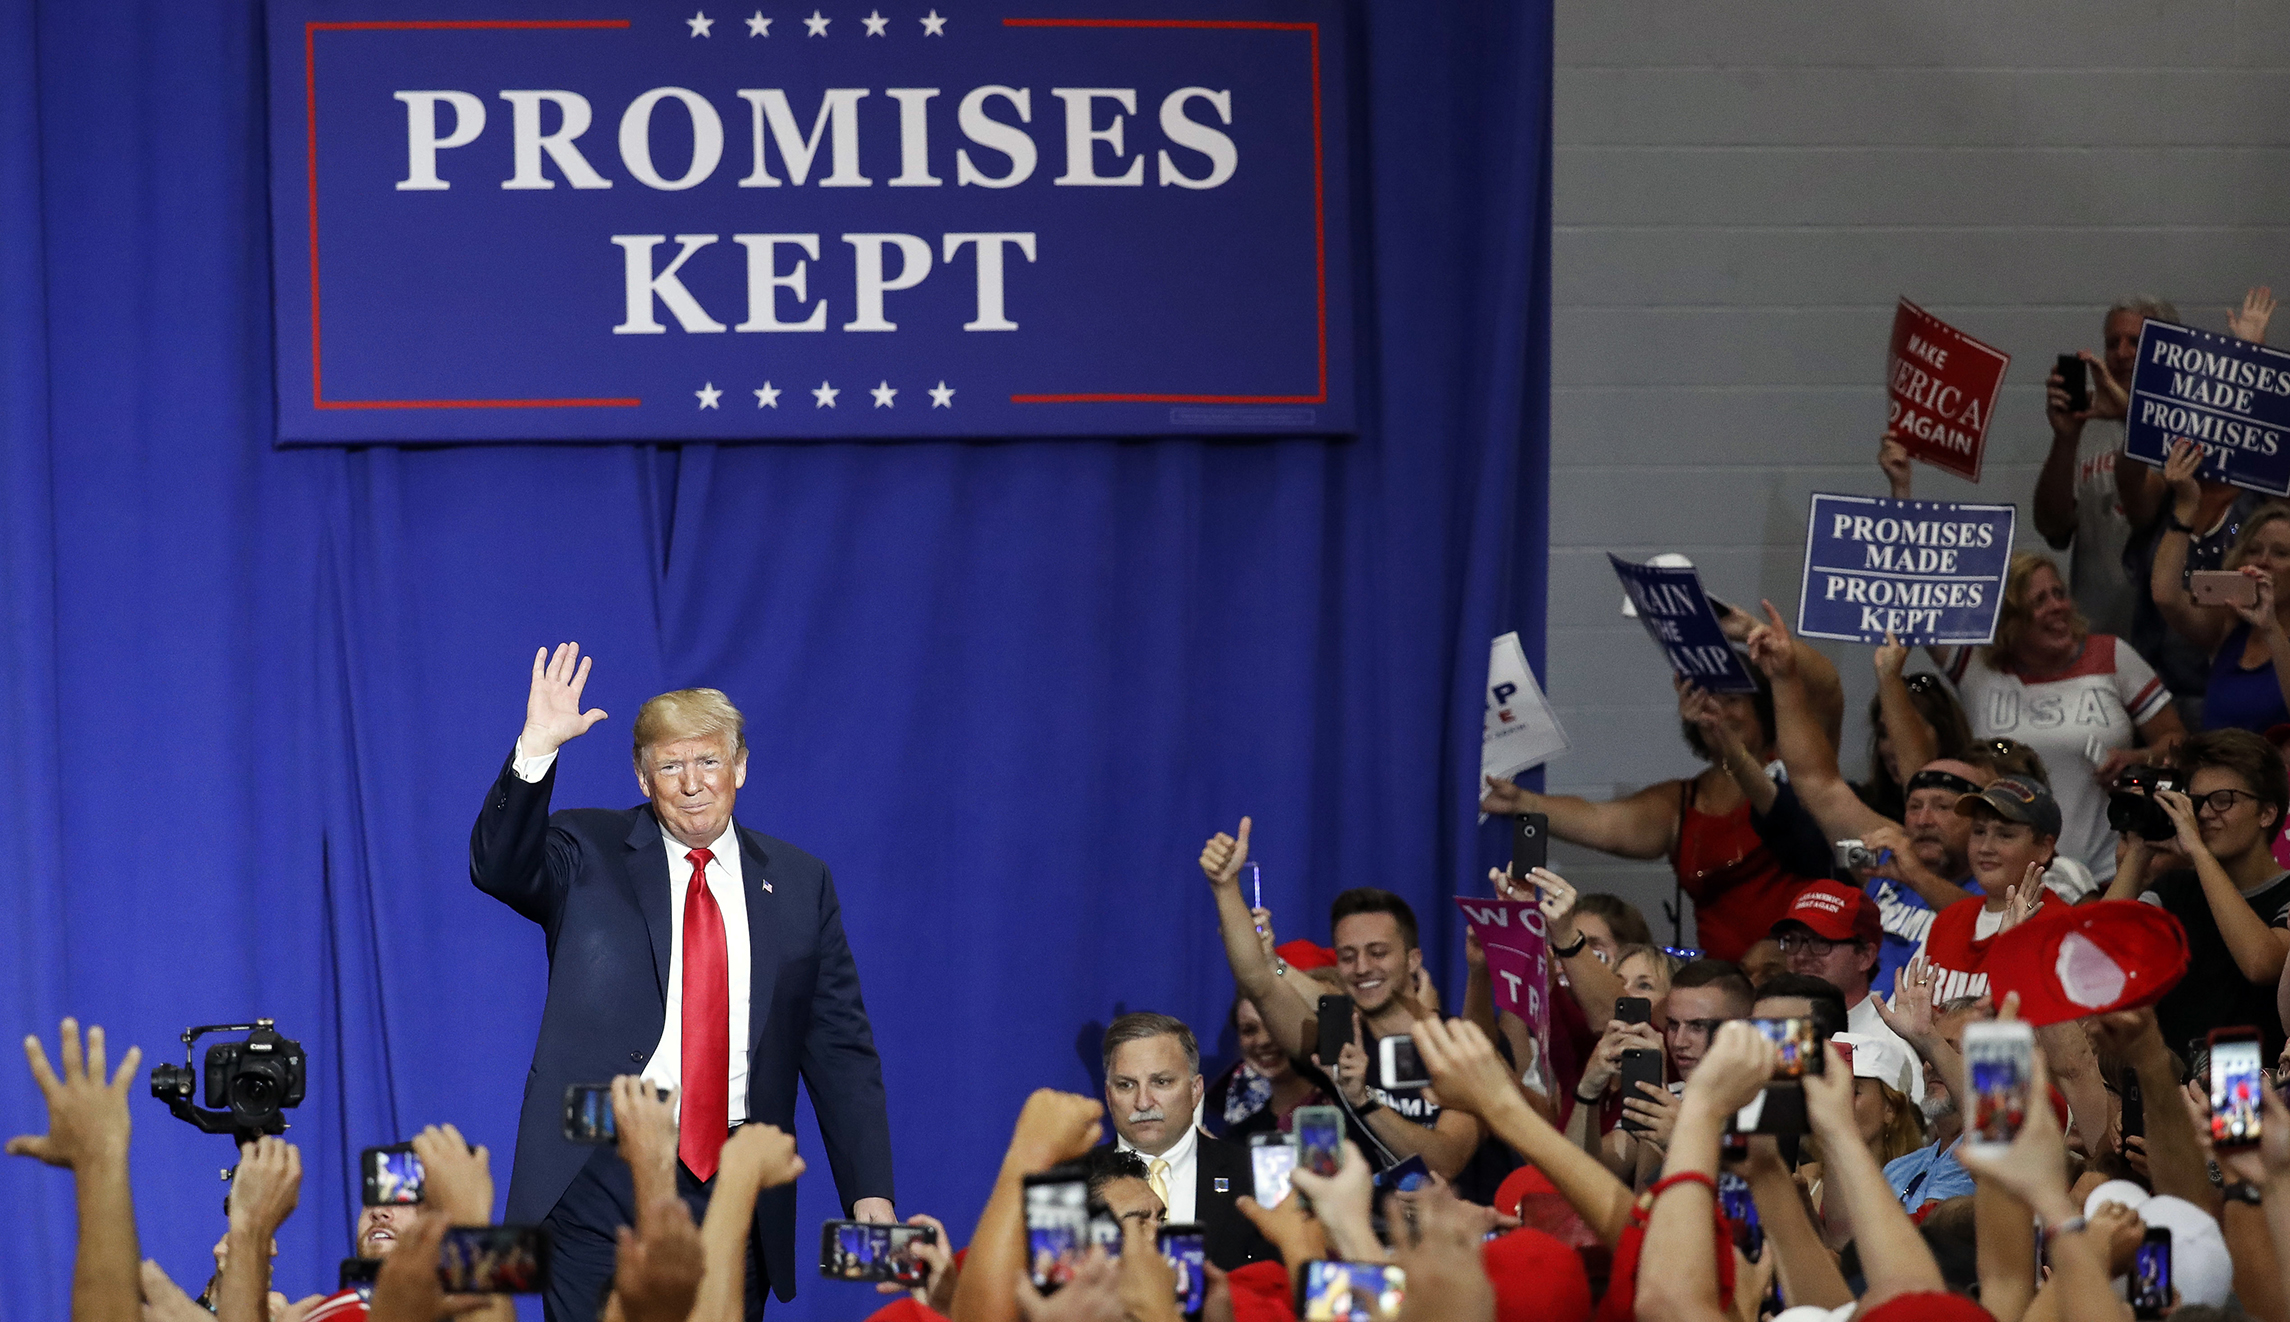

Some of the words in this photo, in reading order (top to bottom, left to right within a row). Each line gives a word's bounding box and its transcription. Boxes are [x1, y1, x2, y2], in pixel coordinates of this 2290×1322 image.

[393, 85, 1238, 191] PROMISES
[610, 232, 1037, 335] KEPT
[1907, 333, 1948, 371] MAKE
[2152, 339, 2290, 397] PROMISES
[1893, 357, 1982, 432] ERICA
[2168, 371, 2255, 415] MADE
[1899, 409, 1973, 456] AGAIN
[2140, 400, 2280, 457] PROMISES
[1831, 513, 1994, 548] PROMISES
[1864, 543, 1959, 574] MADE
[1629, 578, 1698, 616] RAIN
[1825, 574, 1984, 608] PROMISES
[1860, 606, 1944, 634] KEPT
[1985, 685, 2111, 735] USA
